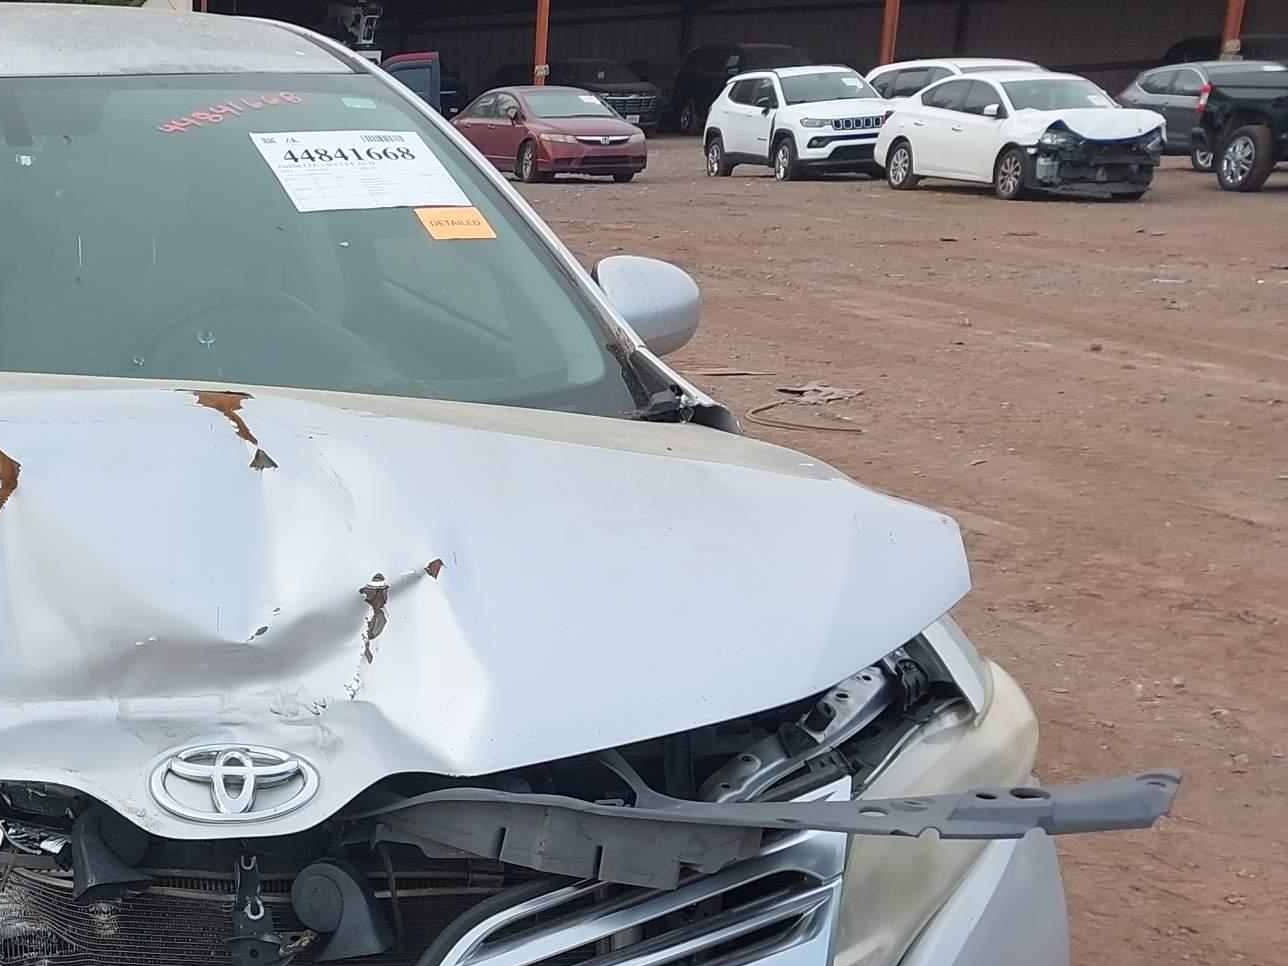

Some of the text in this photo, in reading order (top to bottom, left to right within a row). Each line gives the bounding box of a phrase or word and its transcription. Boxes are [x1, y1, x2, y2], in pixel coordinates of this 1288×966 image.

[157, 91, 302, 132] 44841668
[283, 146, 416, 163] 44841668
[429, 219, 481, 227] DETAILED
